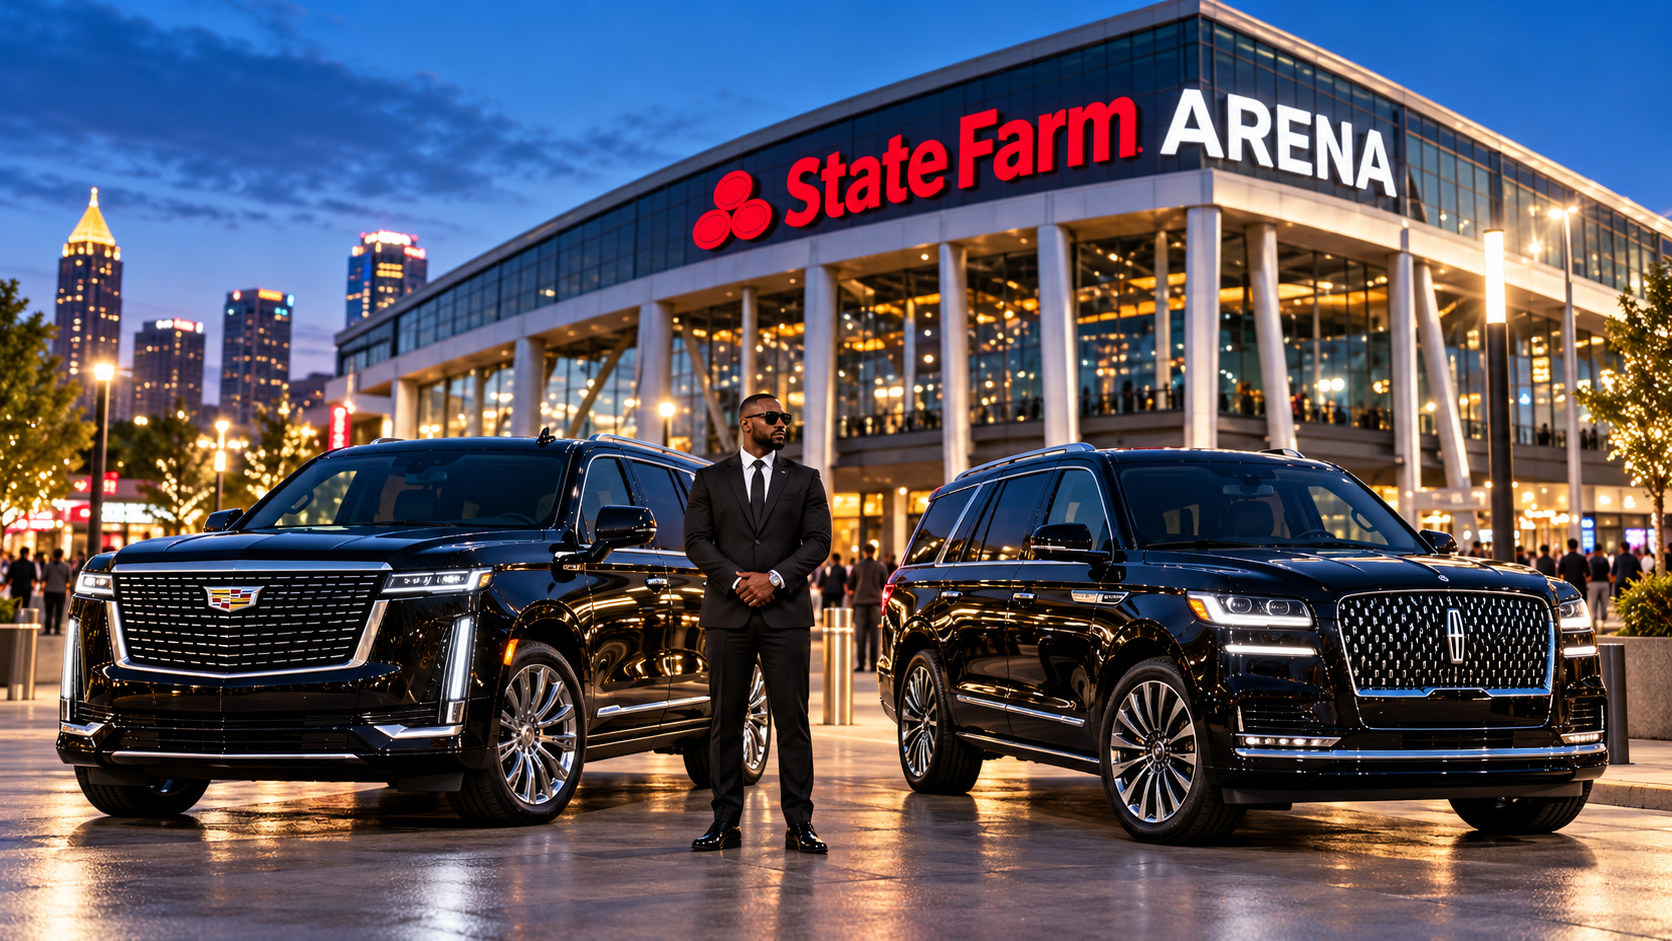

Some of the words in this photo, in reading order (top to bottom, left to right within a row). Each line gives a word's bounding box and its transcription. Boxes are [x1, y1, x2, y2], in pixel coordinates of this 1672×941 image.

[785, 134, 948, 228] State
[957, 96, 1138, 190] Farm
[1160, 88, 1398, 198] ARENA
